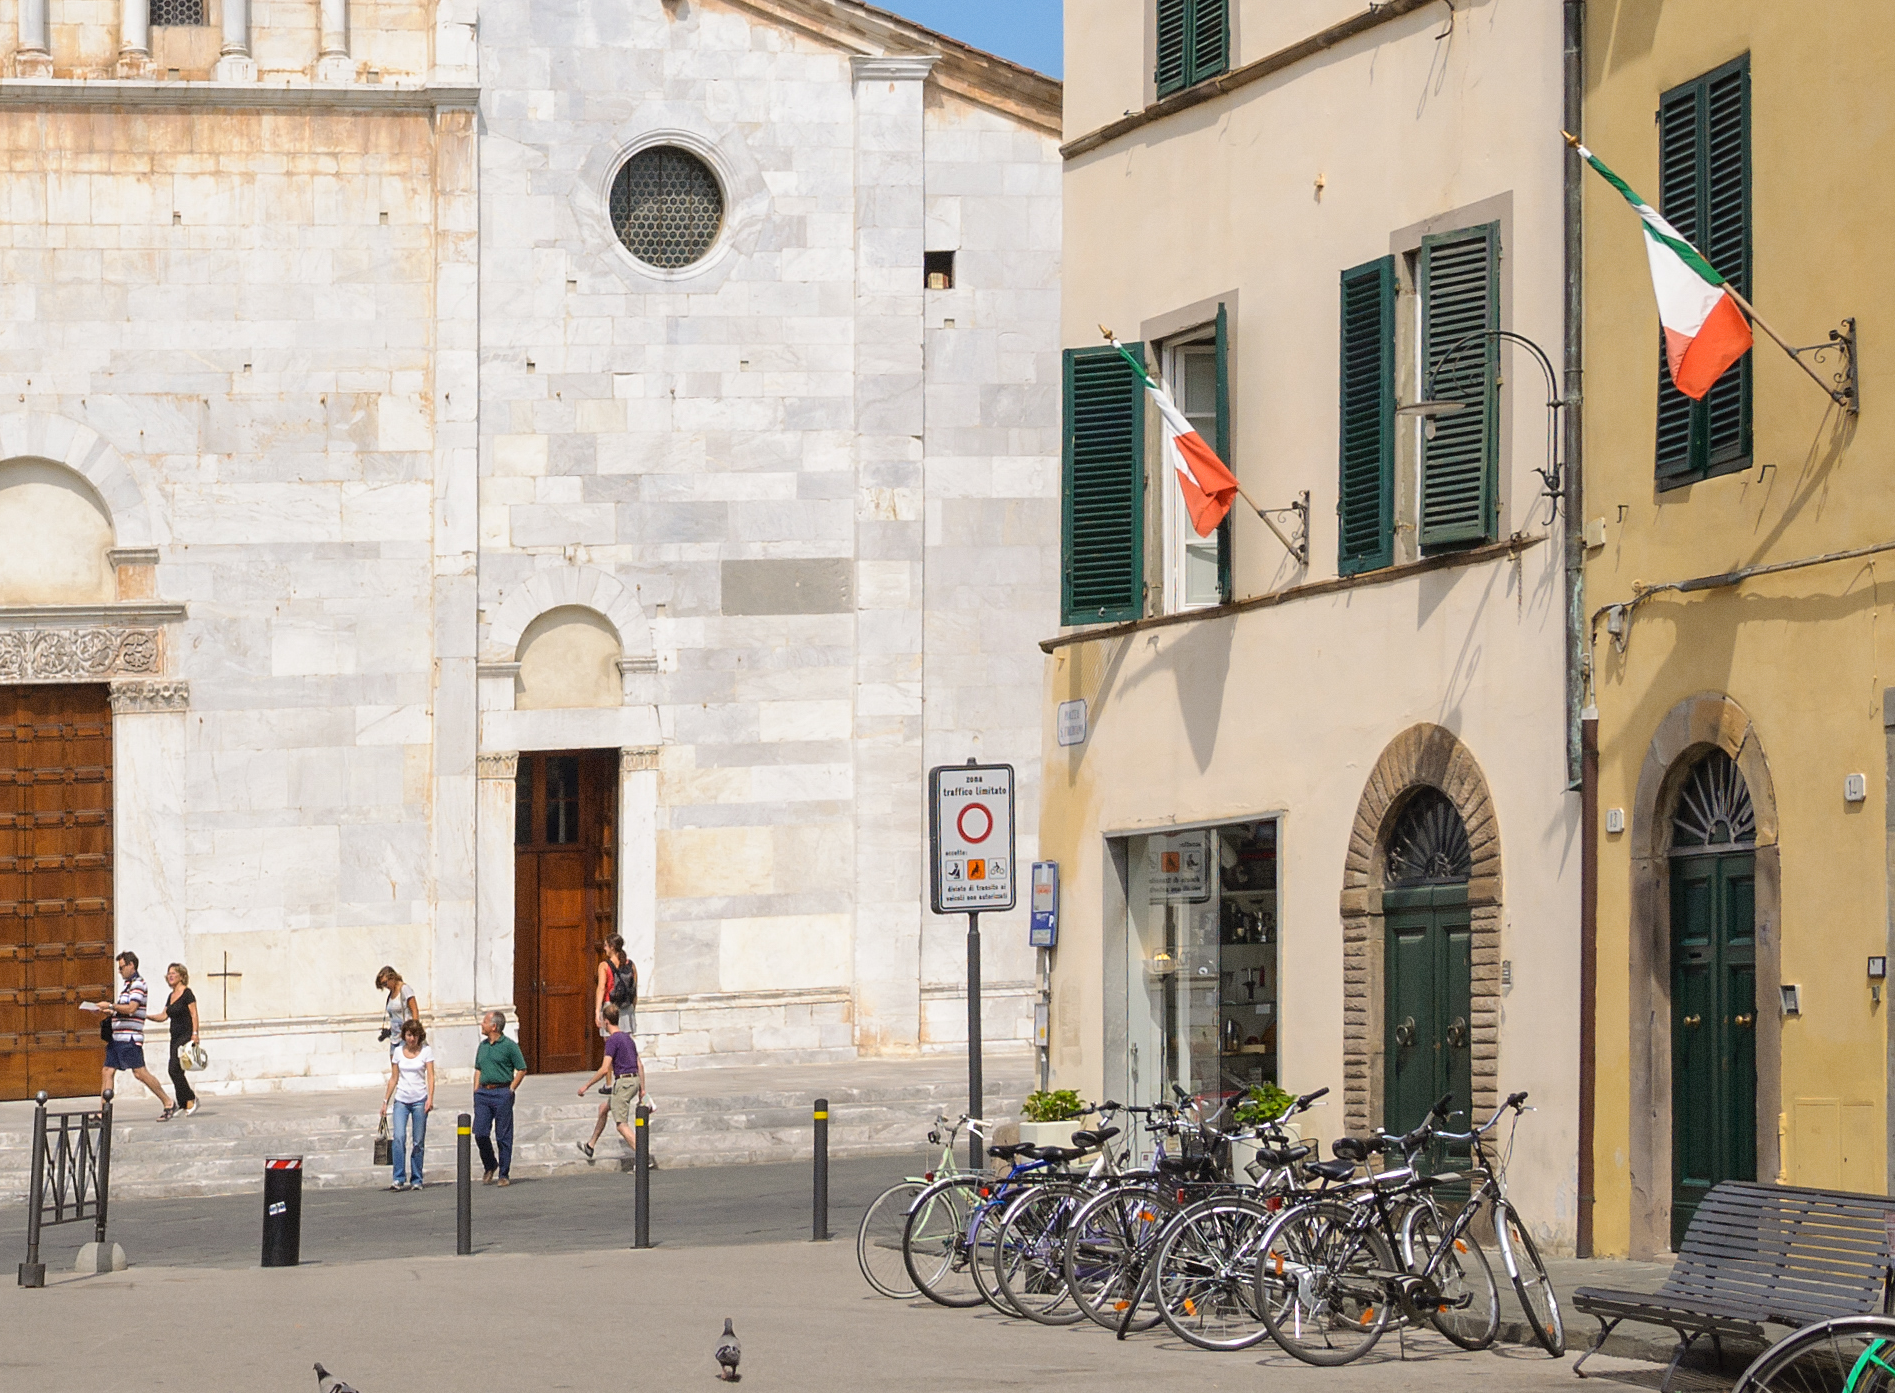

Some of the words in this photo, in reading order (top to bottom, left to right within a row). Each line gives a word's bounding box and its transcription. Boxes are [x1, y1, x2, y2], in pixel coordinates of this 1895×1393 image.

[966, 776, 983, 784] zona
[943, 787, 973, 797] traffico
[975, 785, 1007, 796] limitato
[968, 884, 974, 892] di
[976, 884, 999, 892] transito
